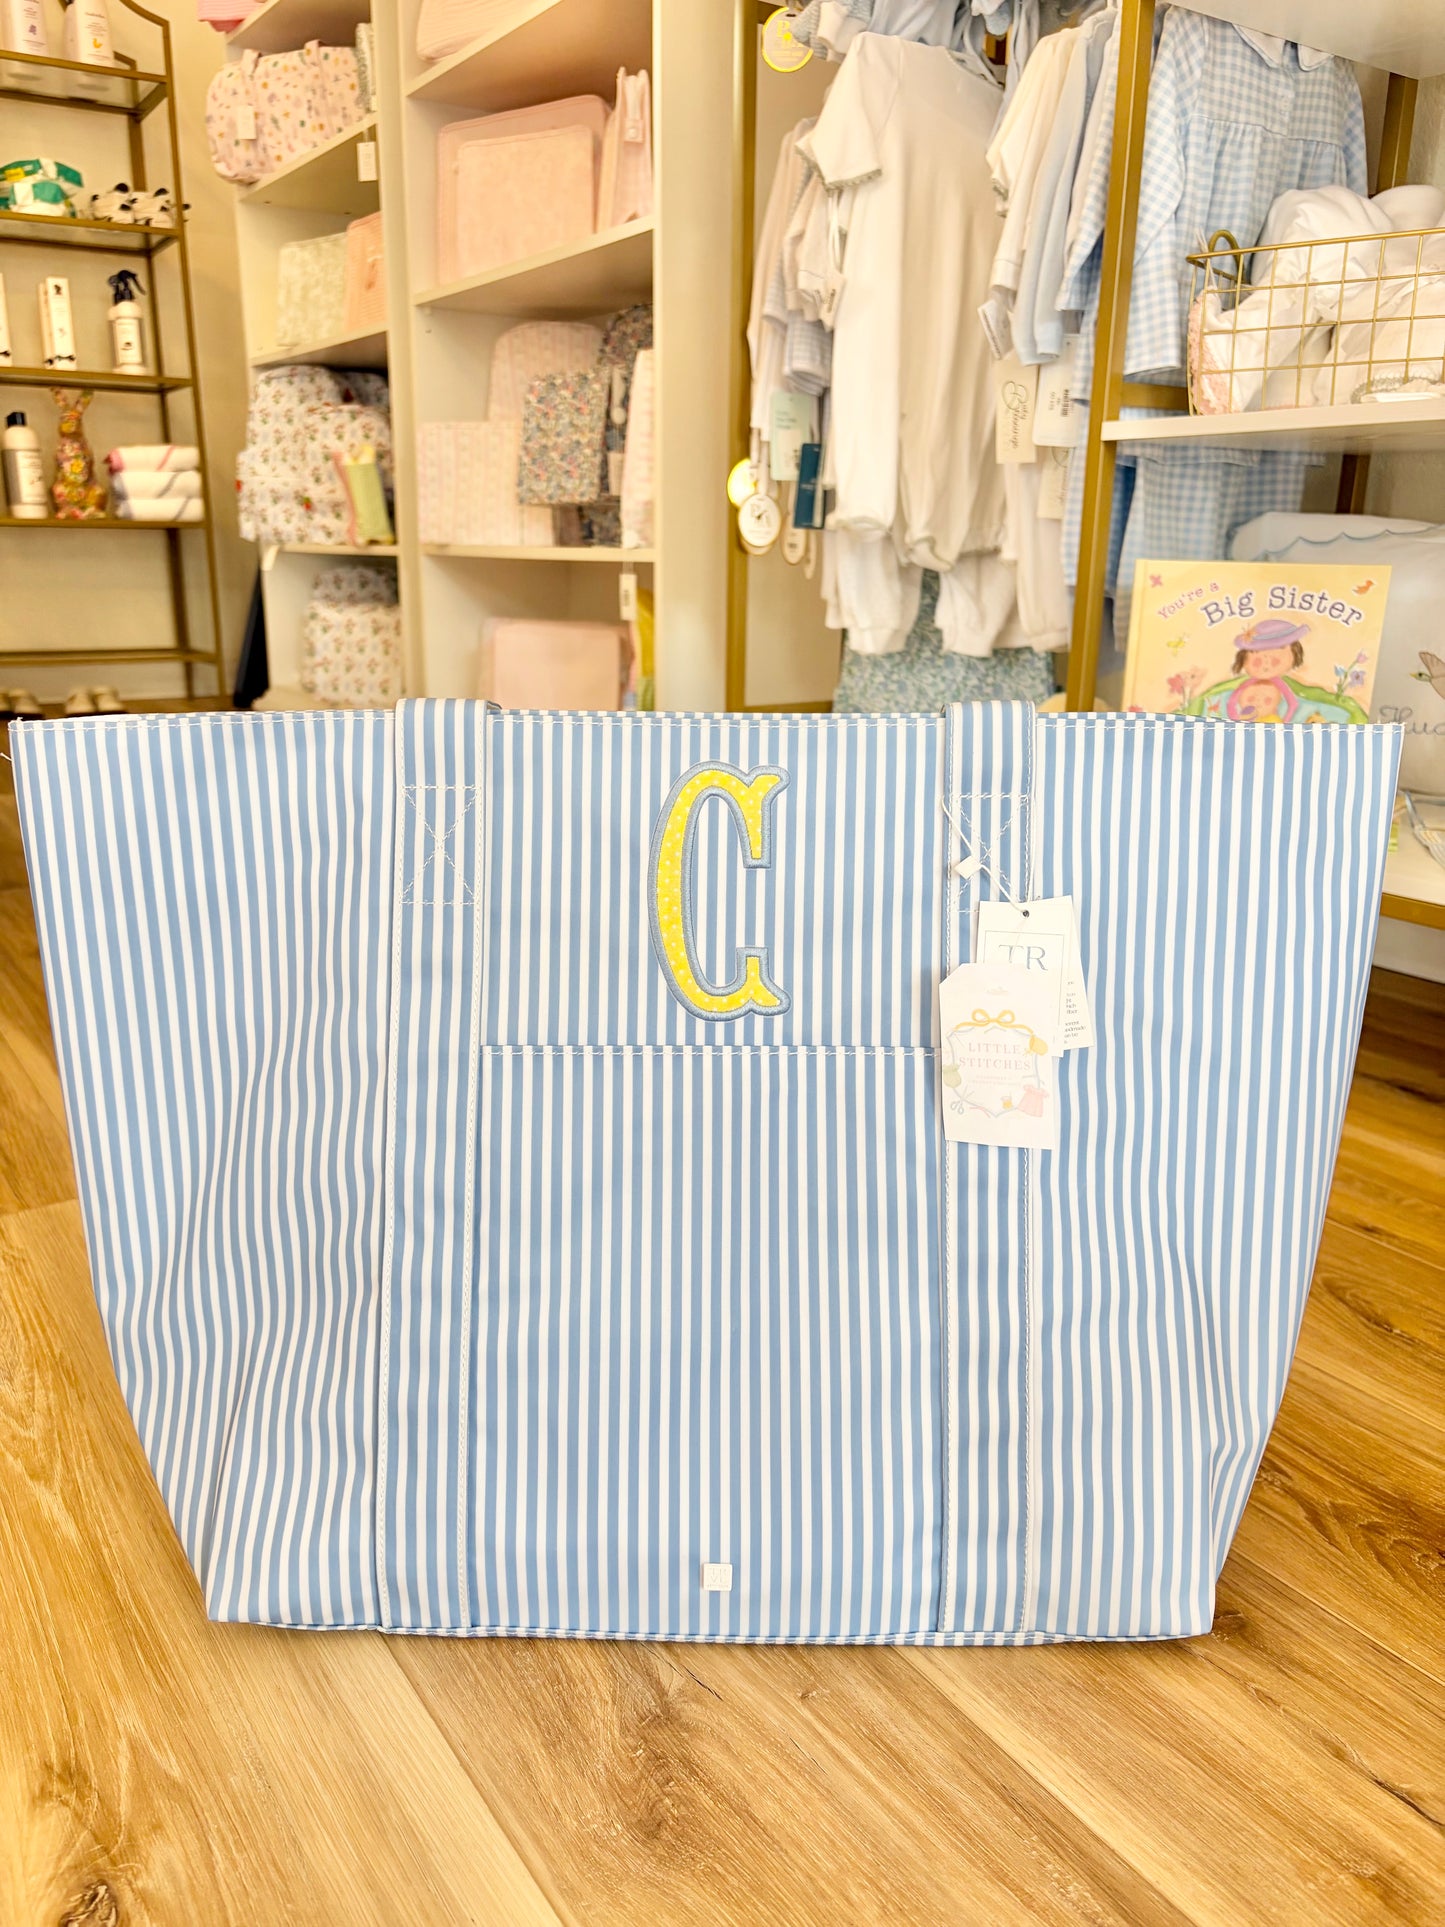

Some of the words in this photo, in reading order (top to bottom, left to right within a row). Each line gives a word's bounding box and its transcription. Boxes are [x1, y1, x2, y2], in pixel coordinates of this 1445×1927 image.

[1158, 588, 1203, 618] You're
[1210, 582, 1219, 592] a
[1200, 592, 1255, 626] Big
[1269, 586, 1363, 626] Sister
[648, 760, 791, 1022] C
[999, 944, 1049, 971] TR
[959, 1056, 1031, 1071] STITCHES
[968, 1041, 1022, 1055] LITTLE
